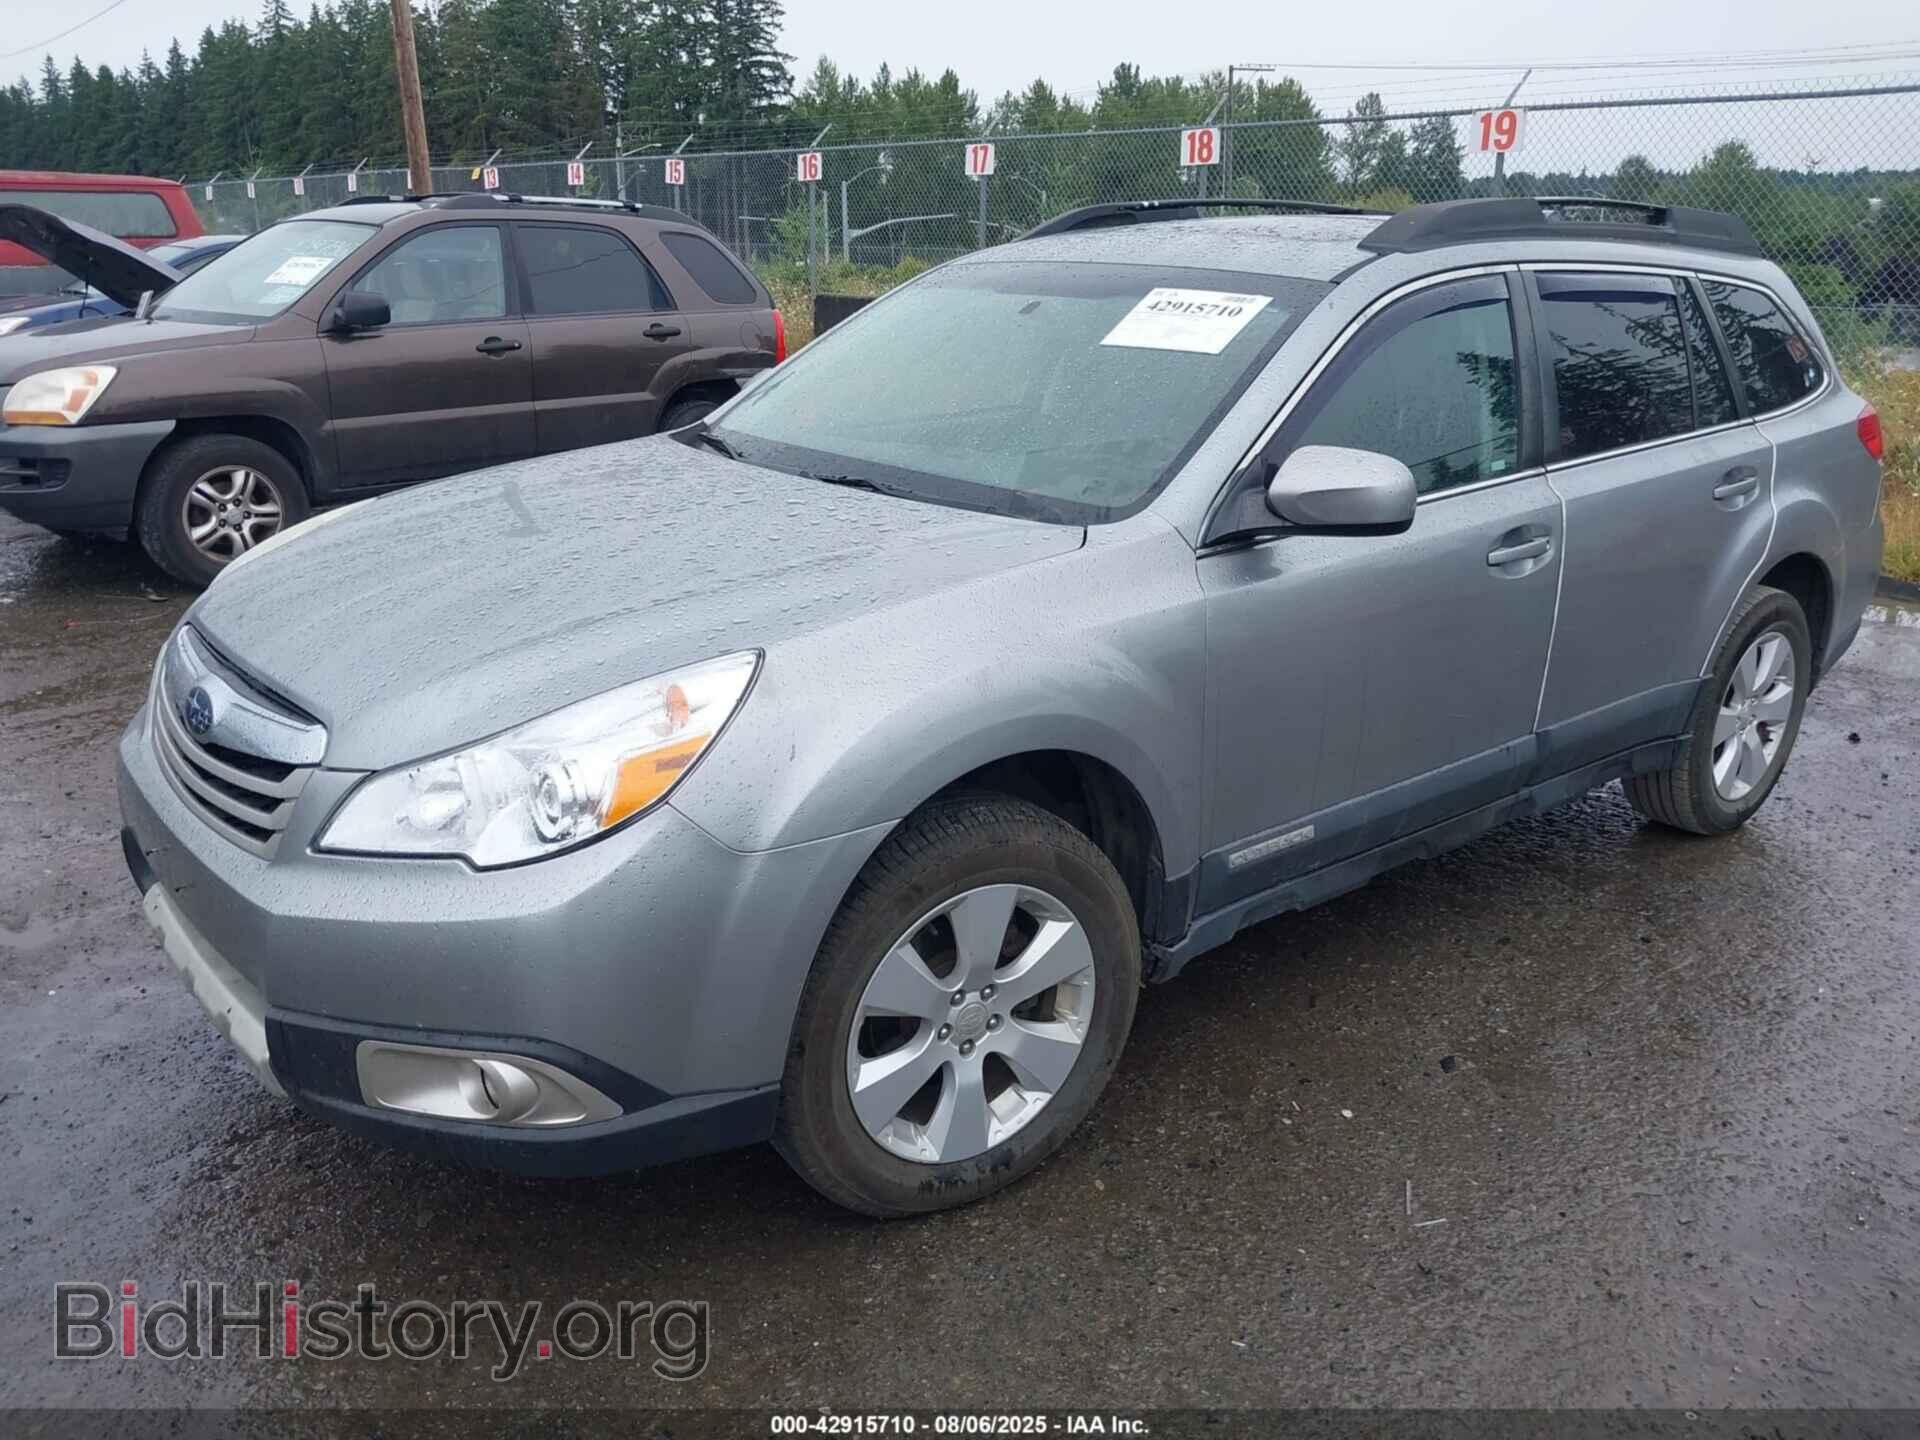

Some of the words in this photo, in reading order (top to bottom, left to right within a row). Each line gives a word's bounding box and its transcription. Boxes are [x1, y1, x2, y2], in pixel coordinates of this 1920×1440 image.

[1480, 110, 1517, 151] 19
[972, 145, 989, 173] 17
[1187, 130, 1213, 163] 18
[486, 168, 496, 187] 13
[570, 164, 582, 184] 14
[668, 160, 682, 183] 15
[801, 153, 819, 180] 16
[1146, 300, 1243, 318] 42915710
